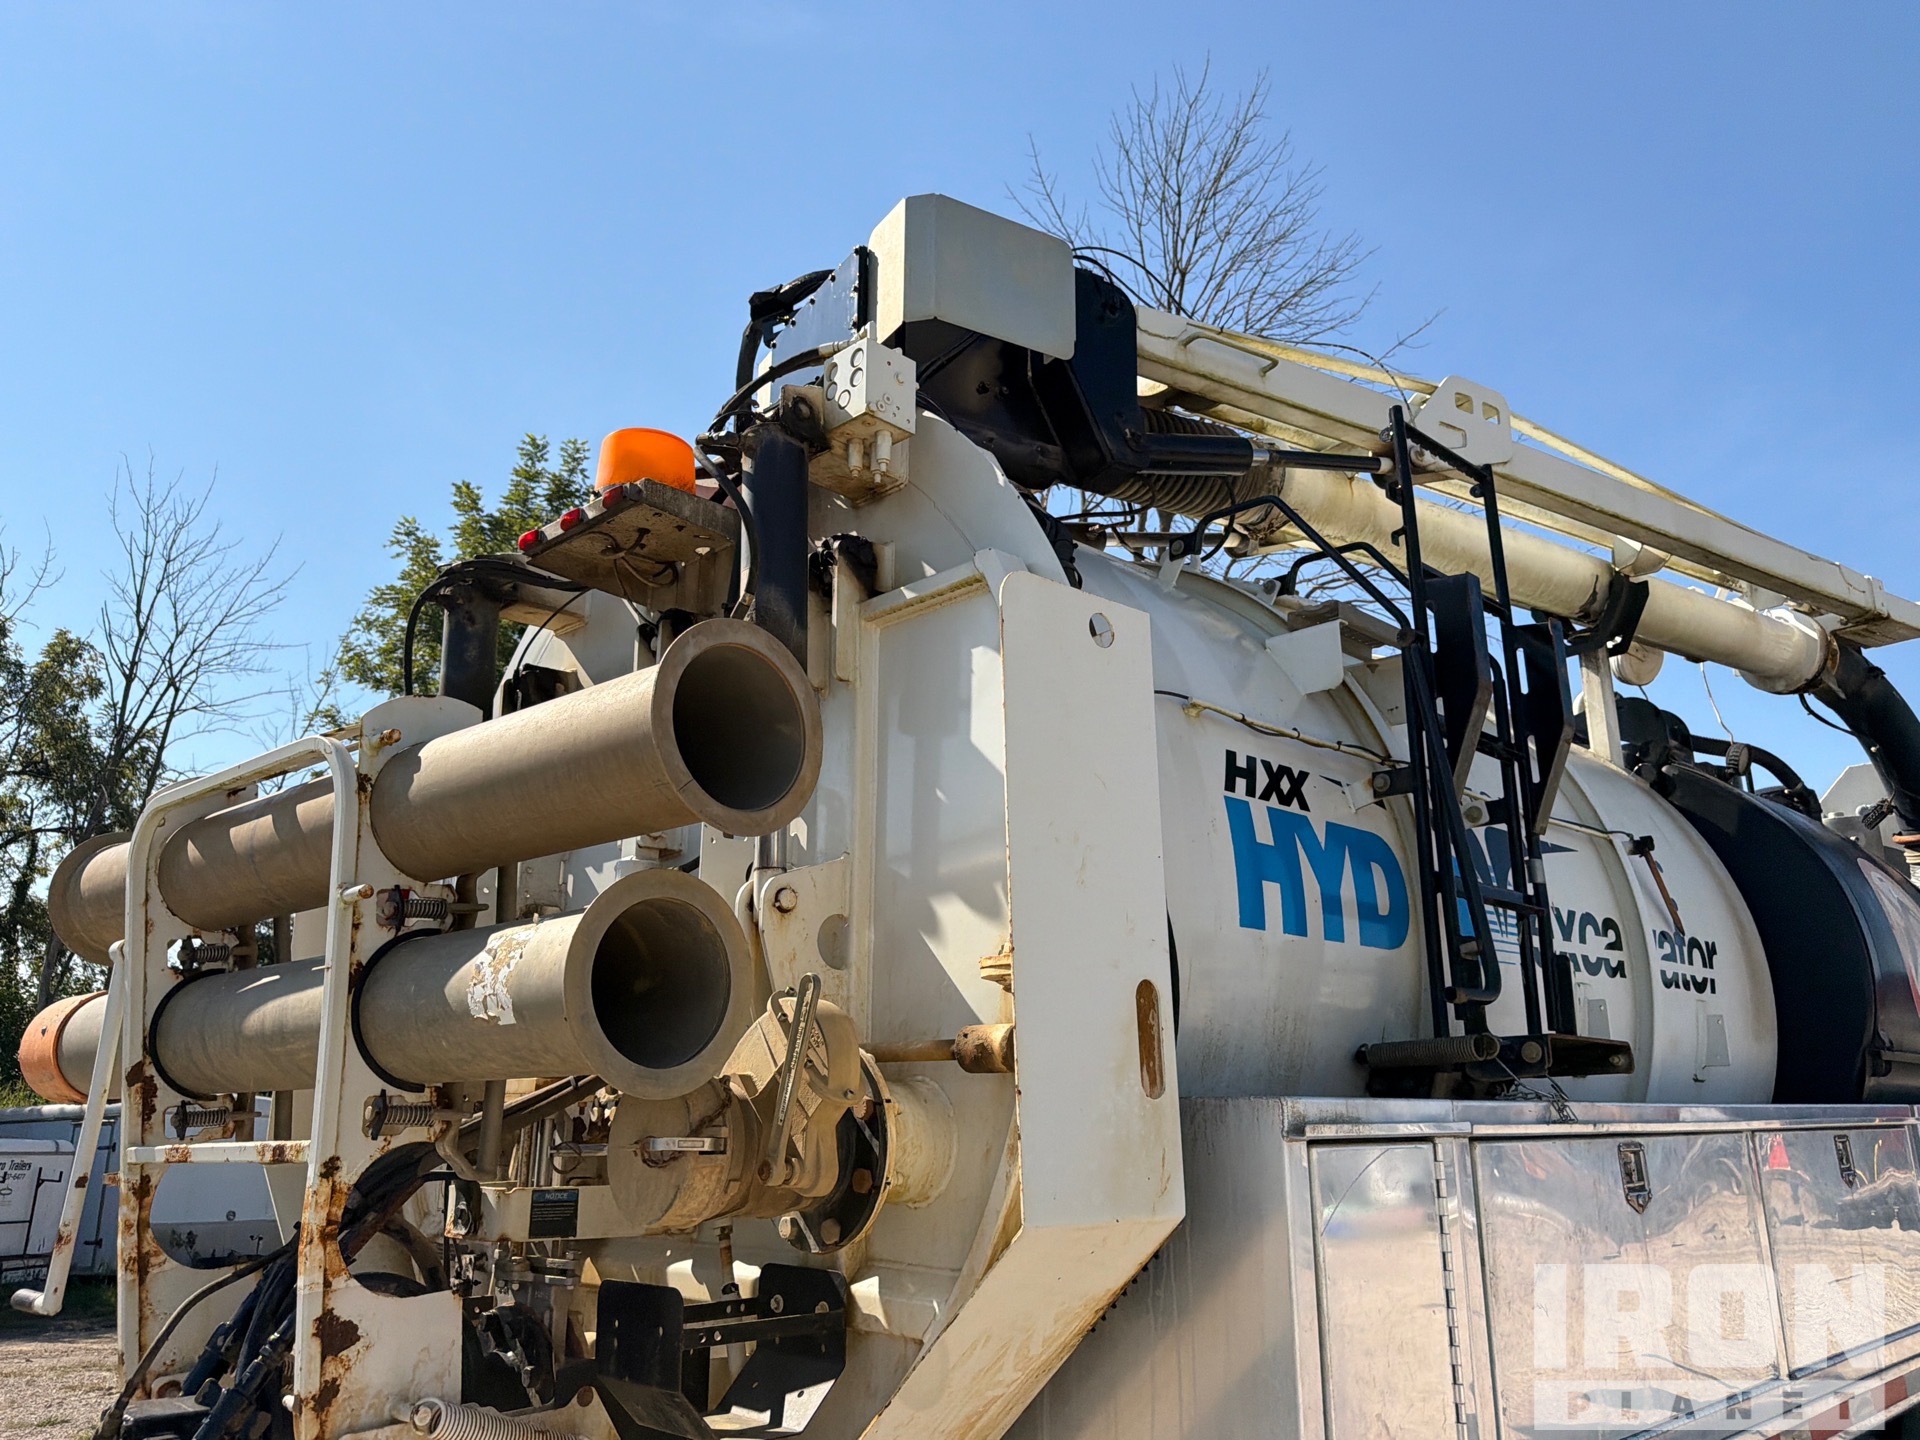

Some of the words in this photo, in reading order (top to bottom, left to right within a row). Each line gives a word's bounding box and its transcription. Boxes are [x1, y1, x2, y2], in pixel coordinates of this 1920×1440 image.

[1224, 749, 1311, 812] HXX
[9, 1159, 32, 1171] Trailers
[545, 1192, 569, 1200] NOTICE
